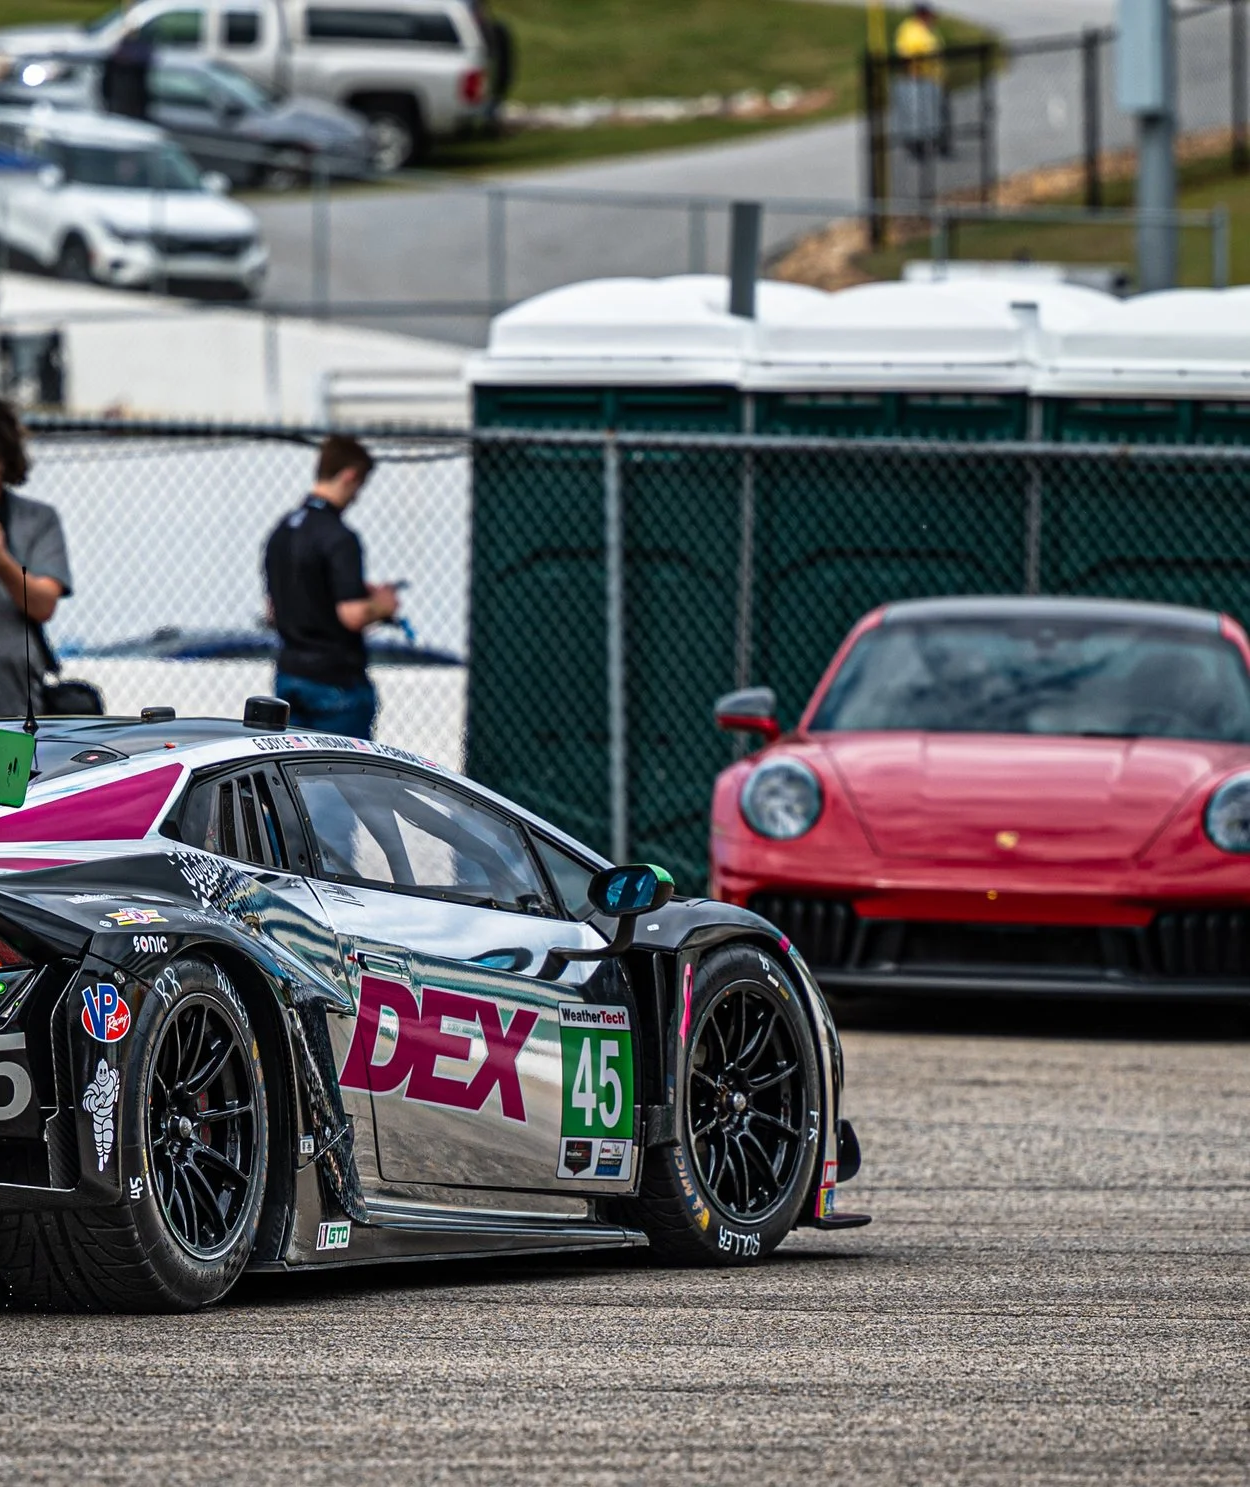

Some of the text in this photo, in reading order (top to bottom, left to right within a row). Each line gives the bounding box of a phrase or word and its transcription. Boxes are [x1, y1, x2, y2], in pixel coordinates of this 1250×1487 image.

[133, 935, 168, 953] SONIC
[82, 983, 118, 1040] VP
[106, 1013, 130, 1034] Racing
[561, 1008, 625, 1025] WeatherTech
[338, 973, 540, 1124] DEX
[572, 1037, 623, 1128] 45
[328, 1225, 349, 1244] GTD
[718, 1225, 761, 1256] ROLLER
